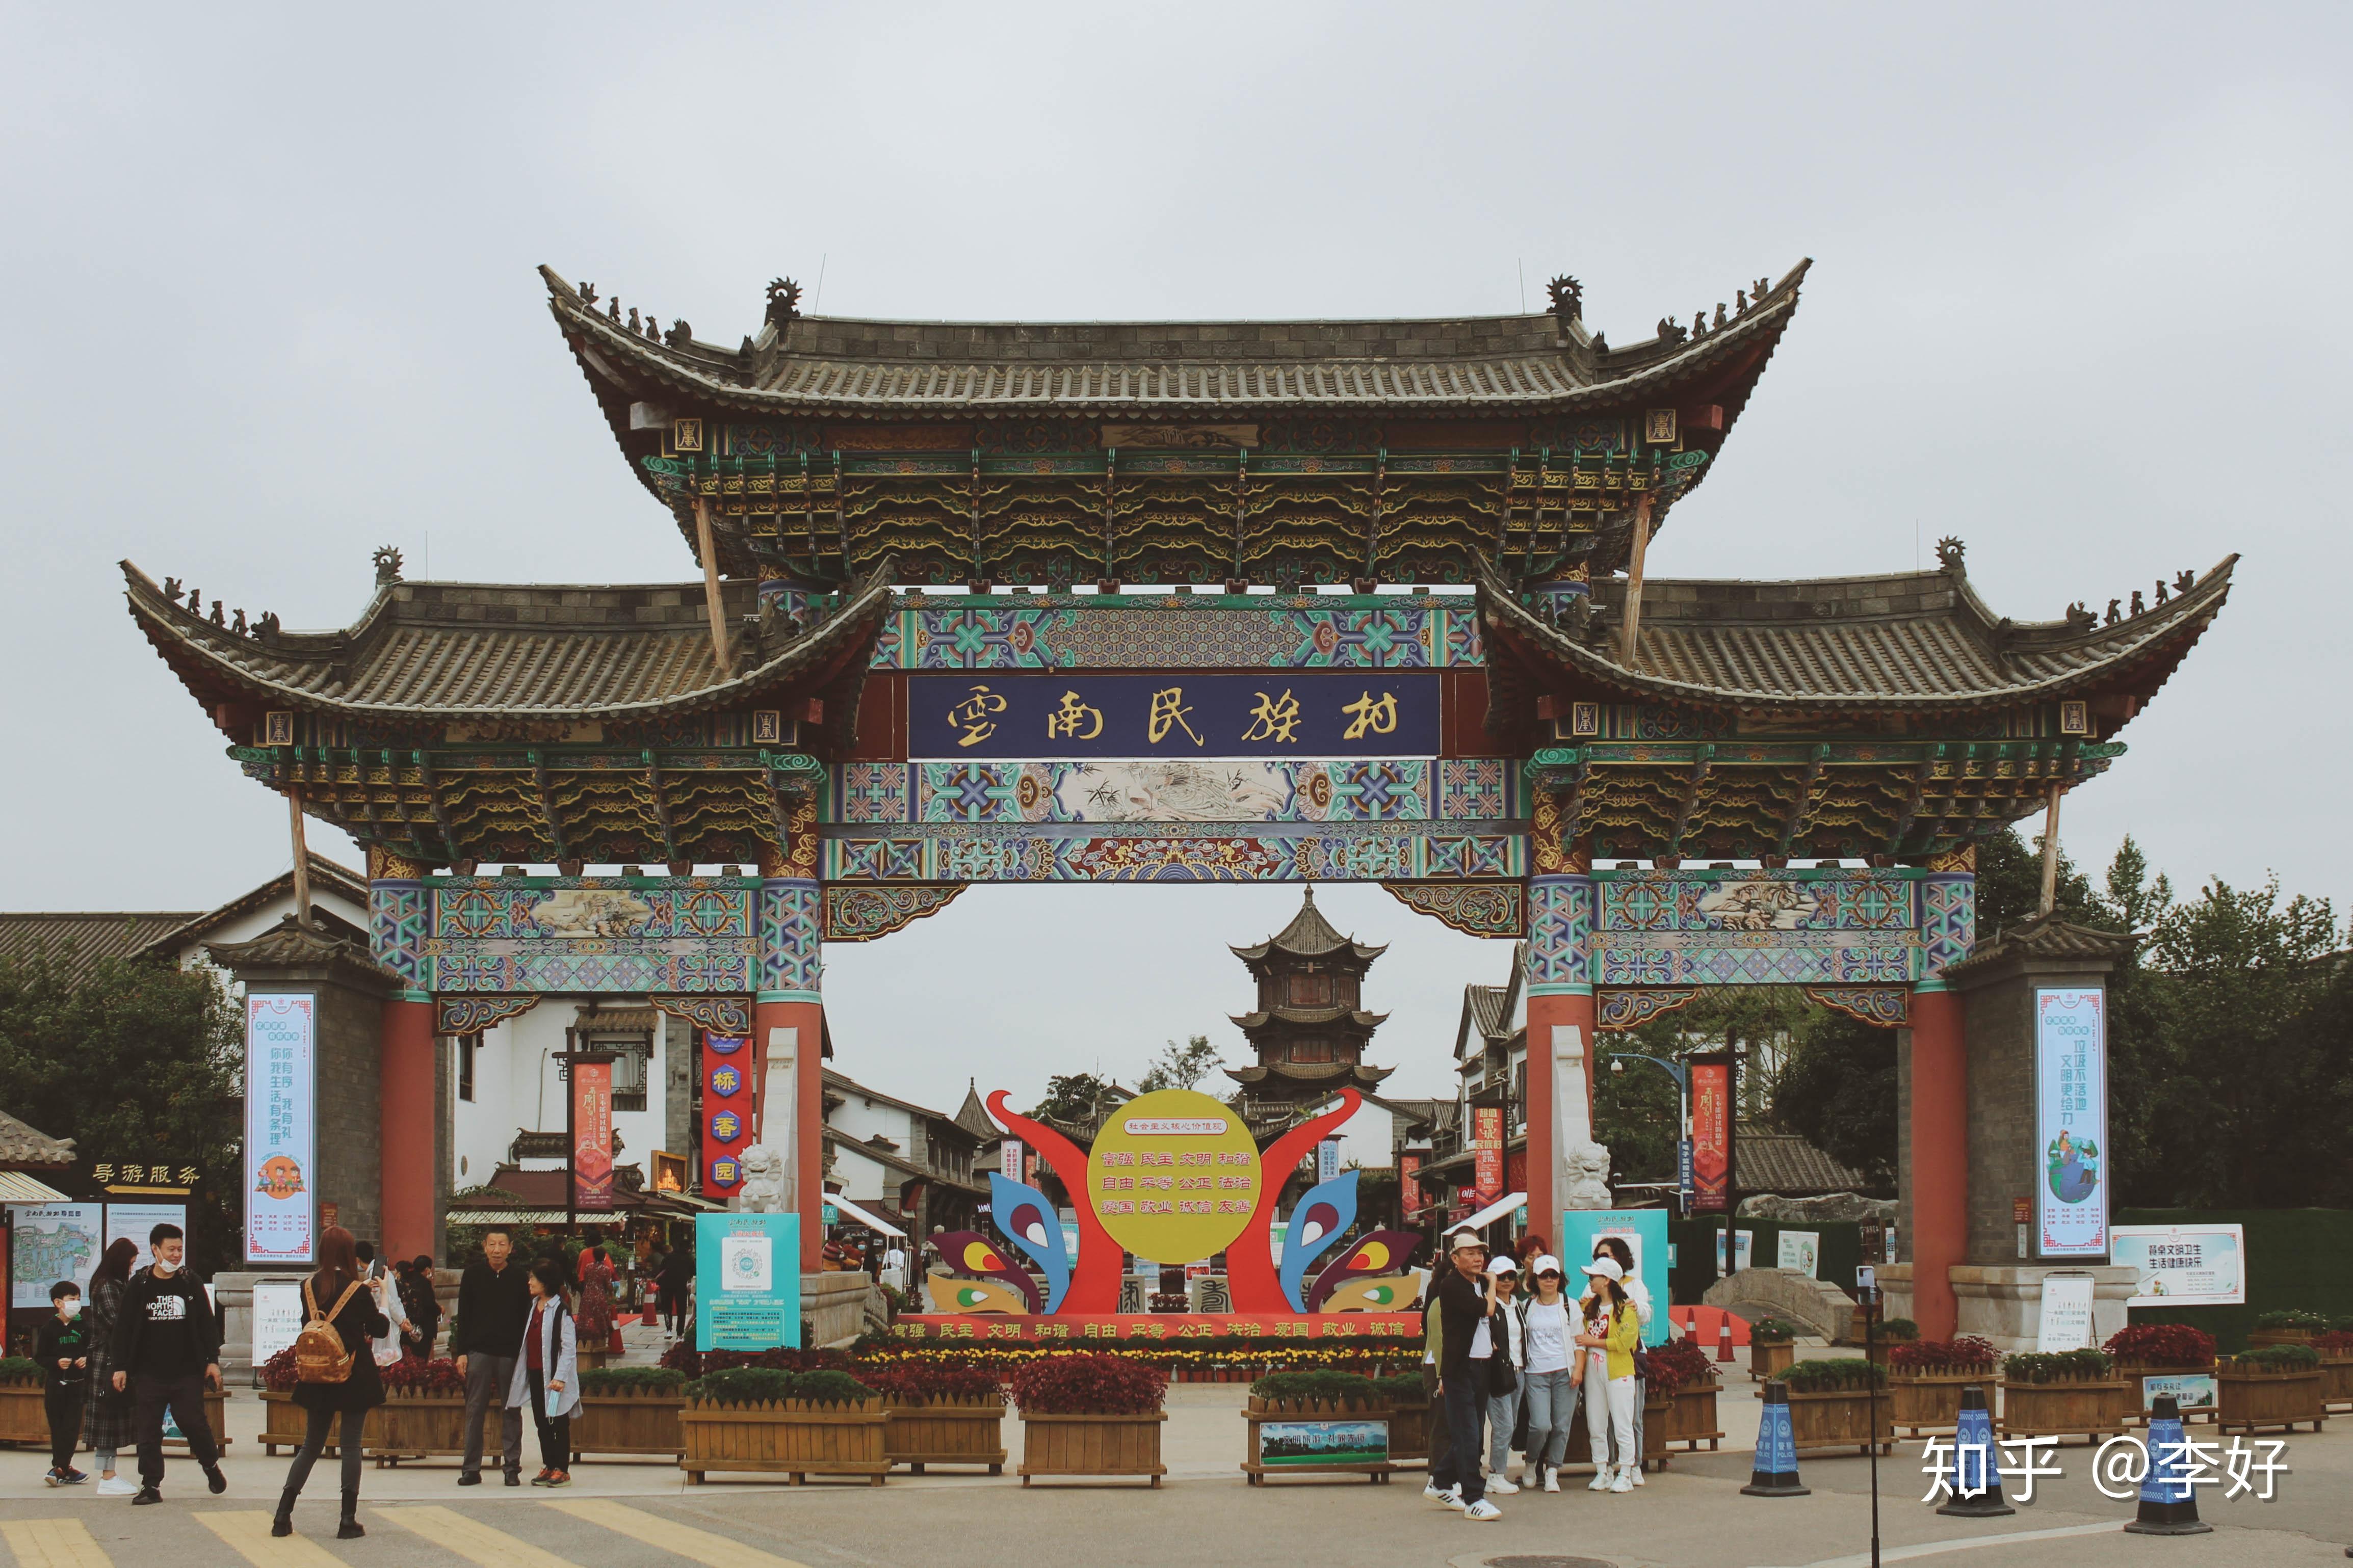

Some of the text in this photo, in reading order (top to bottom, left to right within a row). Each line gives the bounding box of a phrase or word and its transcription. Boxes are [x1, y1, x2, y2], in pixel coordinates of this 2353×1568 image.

[2074, 1040, 2086, 1110] 垃圾不落地
[270, 1047, 281, 1145] 你我生活有条理
[282, 1047, 293, 1139] 你有序 我有礼
[2060, 1055, 2073, 1125] 文明更给力
[1480, 1108, 1497, 1118] 超值
[714, 1072, 737, 1180] 桥香园
[1129, 1122, 1222, 1130] 社会主义核心价值观
[1101, 1152, 1251, 1166] 富强 民主 文明 和谐
[92, 1163, 200, 1184] 导游服务
[1101, 1177, 1251, 1190] 自由 平等 公正 法治
[1101, 1200, 1251, 1215] 爱国 敬业 诚信 友善
[2149, 1244, 2202, 1256] 餐桌文明卫生
[2149, 1257, 2202, 1268] 生活健康快乐
[892, 1323, 926, 1338] 富强
[939, 1323, 975, 1338] 民主
[987, 1323, 1021, 1338] 文明
[1035, 1323, 1069, 1338] 和谐
[1084, 1323, 1117, 1338] 自由
[1130, 1322, 1166, 1337] 平等
[1178, 1322, 1213, 1337] 公正
[1226, 1322, 1262, 1337] 法治
[1274, 1322, 1309, 1337] 爱国
[1322, 1322, 1357, 1337] 敬业
[1370, 1322, 1405, 1337] 诚信
[1283, 1434, 1322, 1444] 文明旅游
